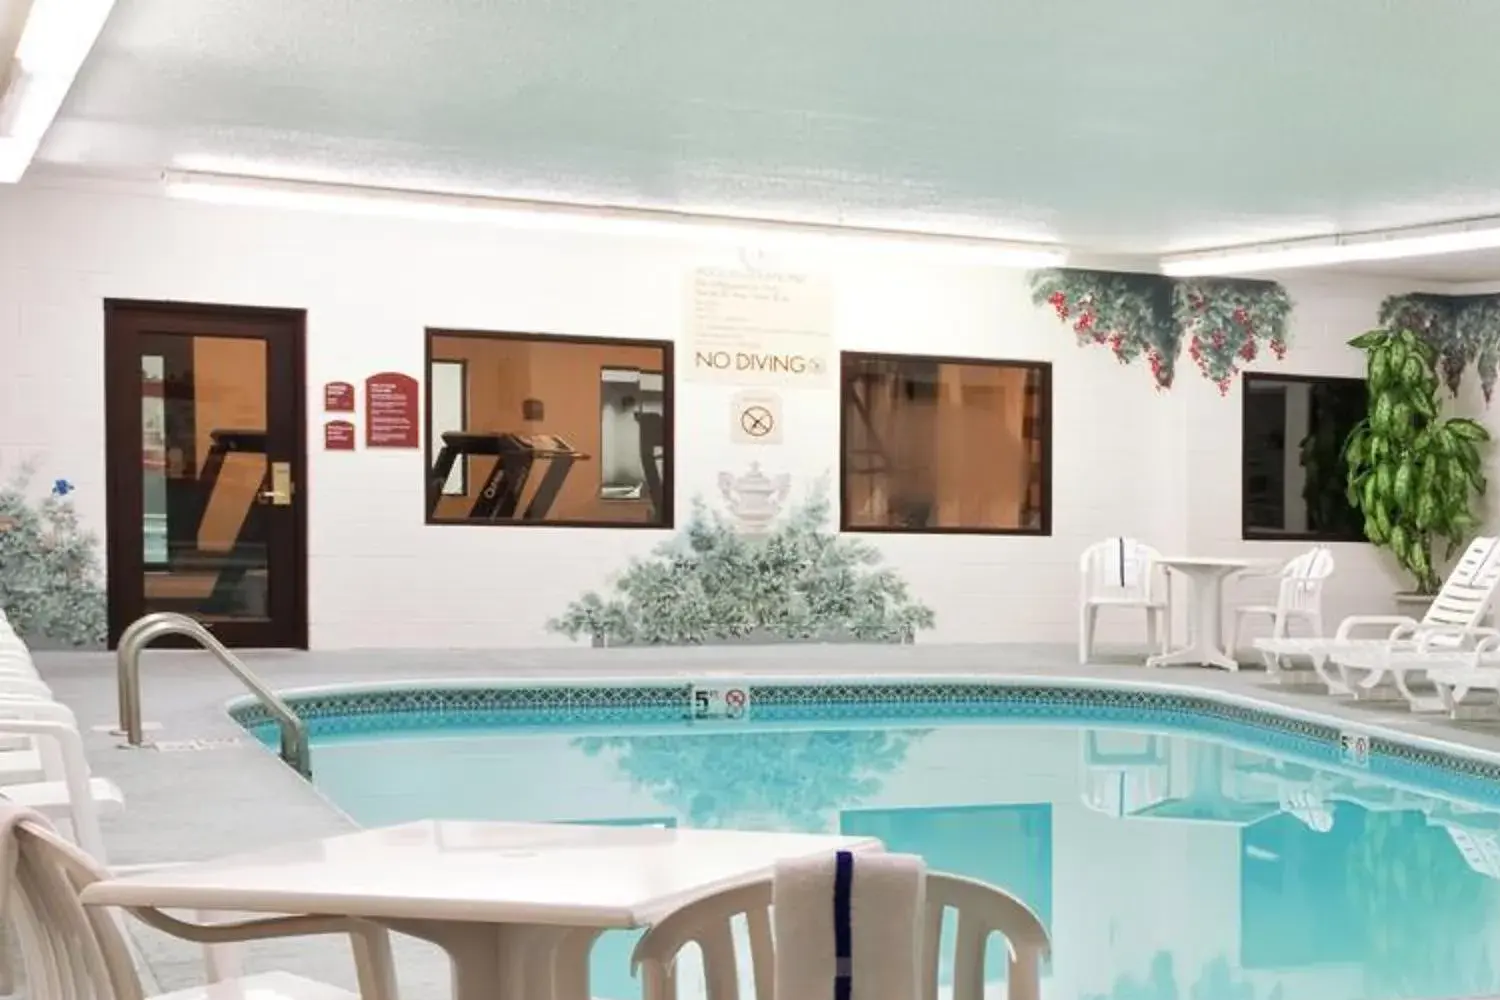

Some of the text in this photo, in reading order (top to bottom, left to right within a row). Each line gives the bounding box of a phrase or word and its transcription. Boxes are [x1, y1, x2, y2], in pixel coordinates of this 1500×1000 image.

[695, 351, 806, 373] NO DIVING
[695, 691, 708, 707] 5
